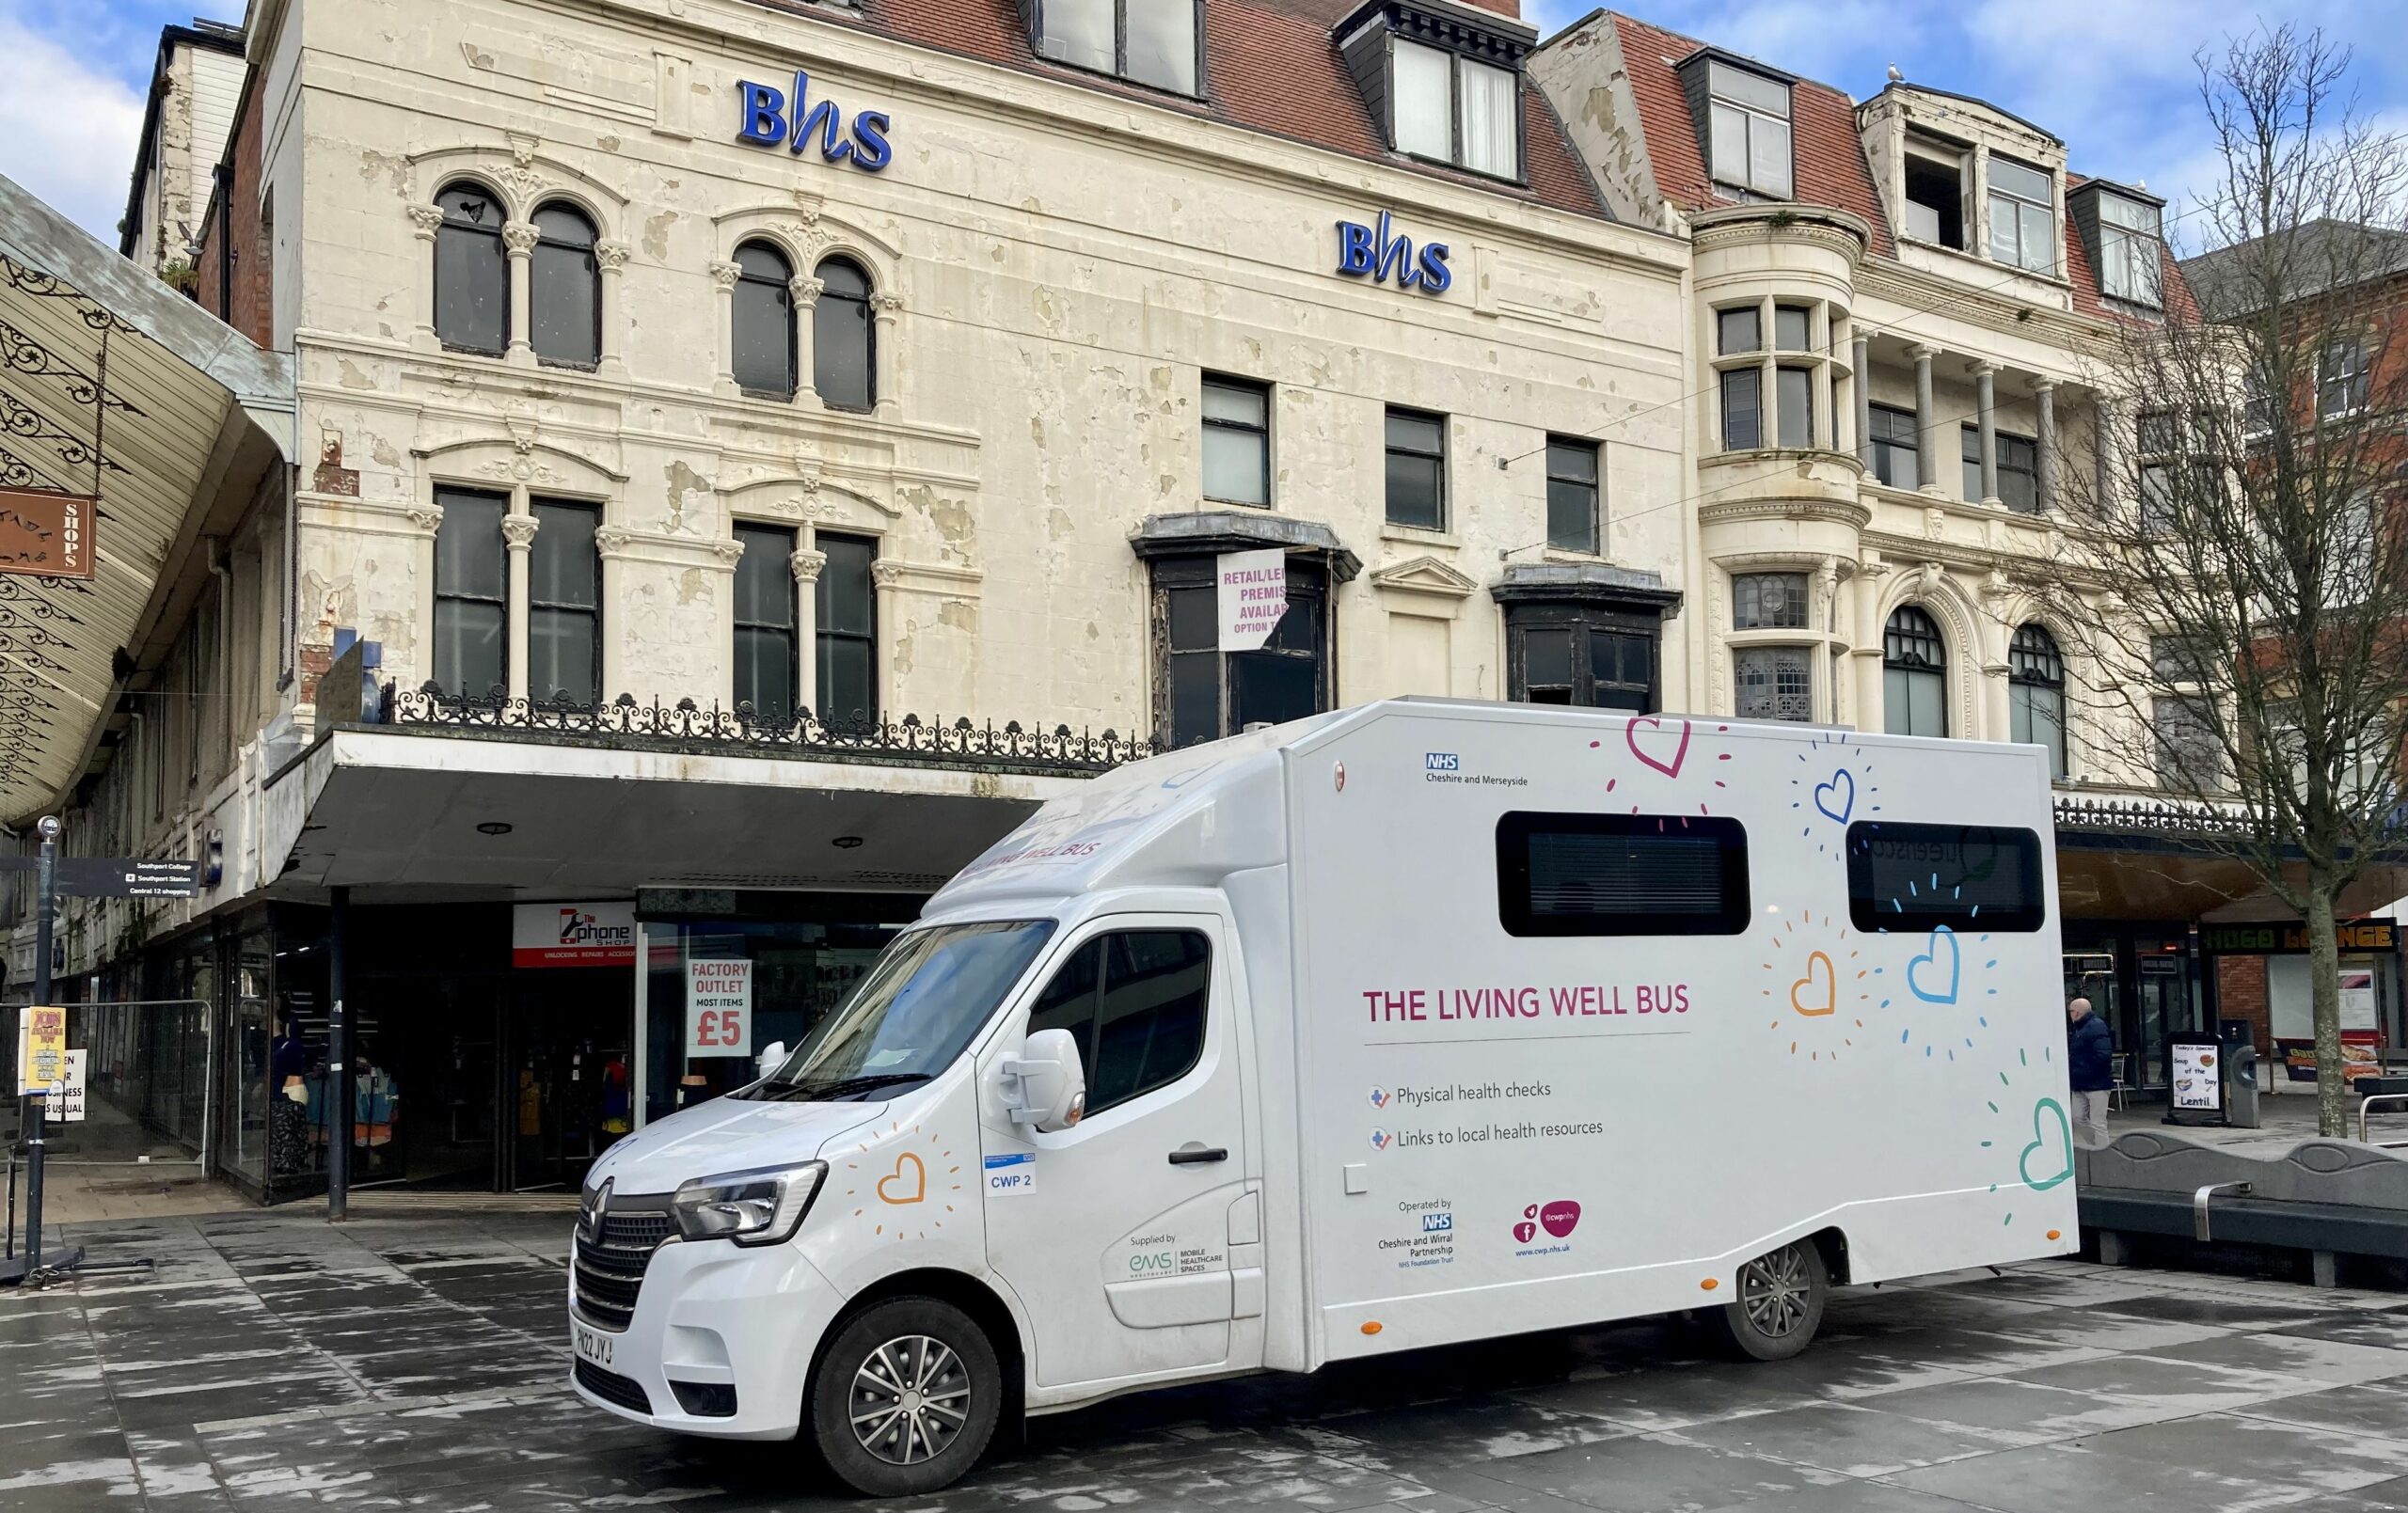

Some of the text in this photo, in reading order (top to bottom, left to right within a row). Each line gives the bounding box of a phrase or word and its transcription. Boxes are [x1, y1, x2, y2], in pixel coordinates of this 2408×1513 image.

[736, 69, 892, 171] Bhs
[1336, 210, 1451, 293] Bhs
[63, 503, 79, 567] SHOPS
[1234, 623, 1267, 634] OPTION
[1427, 753, 1457, 769] NHS
[1426, 773, 1528, 787] Cheshire and Merseyside
[1060, 843, 1101, 856] BUS
[136, 862, 167, 871] Southport
[162, 888, 191, 896] shopping
[577, 924, 630, 943] phone
[692, 964, 748, 976] FACTORY
[696, 981, 744, 993] OUTLET
[696, 999, 743, 1007] MOST ITEMS
[1363, 984, 1689, 1022] THE LIVING WELL BUS
[697, 1010, 741, 1047] £5
[1398, 1080, 1551, 1108] Physical health checks
[2180, 1096, 2210, 1107] Lentil
[1398, 1121, 1603, 1146] Links to local health resources
[991, 1174, 1031, 1189] CWP 2
[1399, 1199, 1451, 1213] Operated by
[1424, 1214, 1451, 1231] NHS
[1545, 1211, 1575, 1221] @cwpnhs
[1131, 1235, 1176, 1247] Supplied by
[1378, 1233, 1453, 1250] Cheshire and Wirral
[1180, 1249, 1205, 1257] MOBILE
[1410, 1245, 1453, 1258] Partnership
[1515, 1244, 1571, 1257] www.cwp.nhs.uk
[1180, 1254, 1223, 1265] HEALTHCARE
[1411, 1258, 1439, 1268] Foundation
[1441, 1256, 1454, 1265] Trust
[1180, 1264, 1205, 1273] SPACES
[594, 1337, 612, 1364] JYJ
